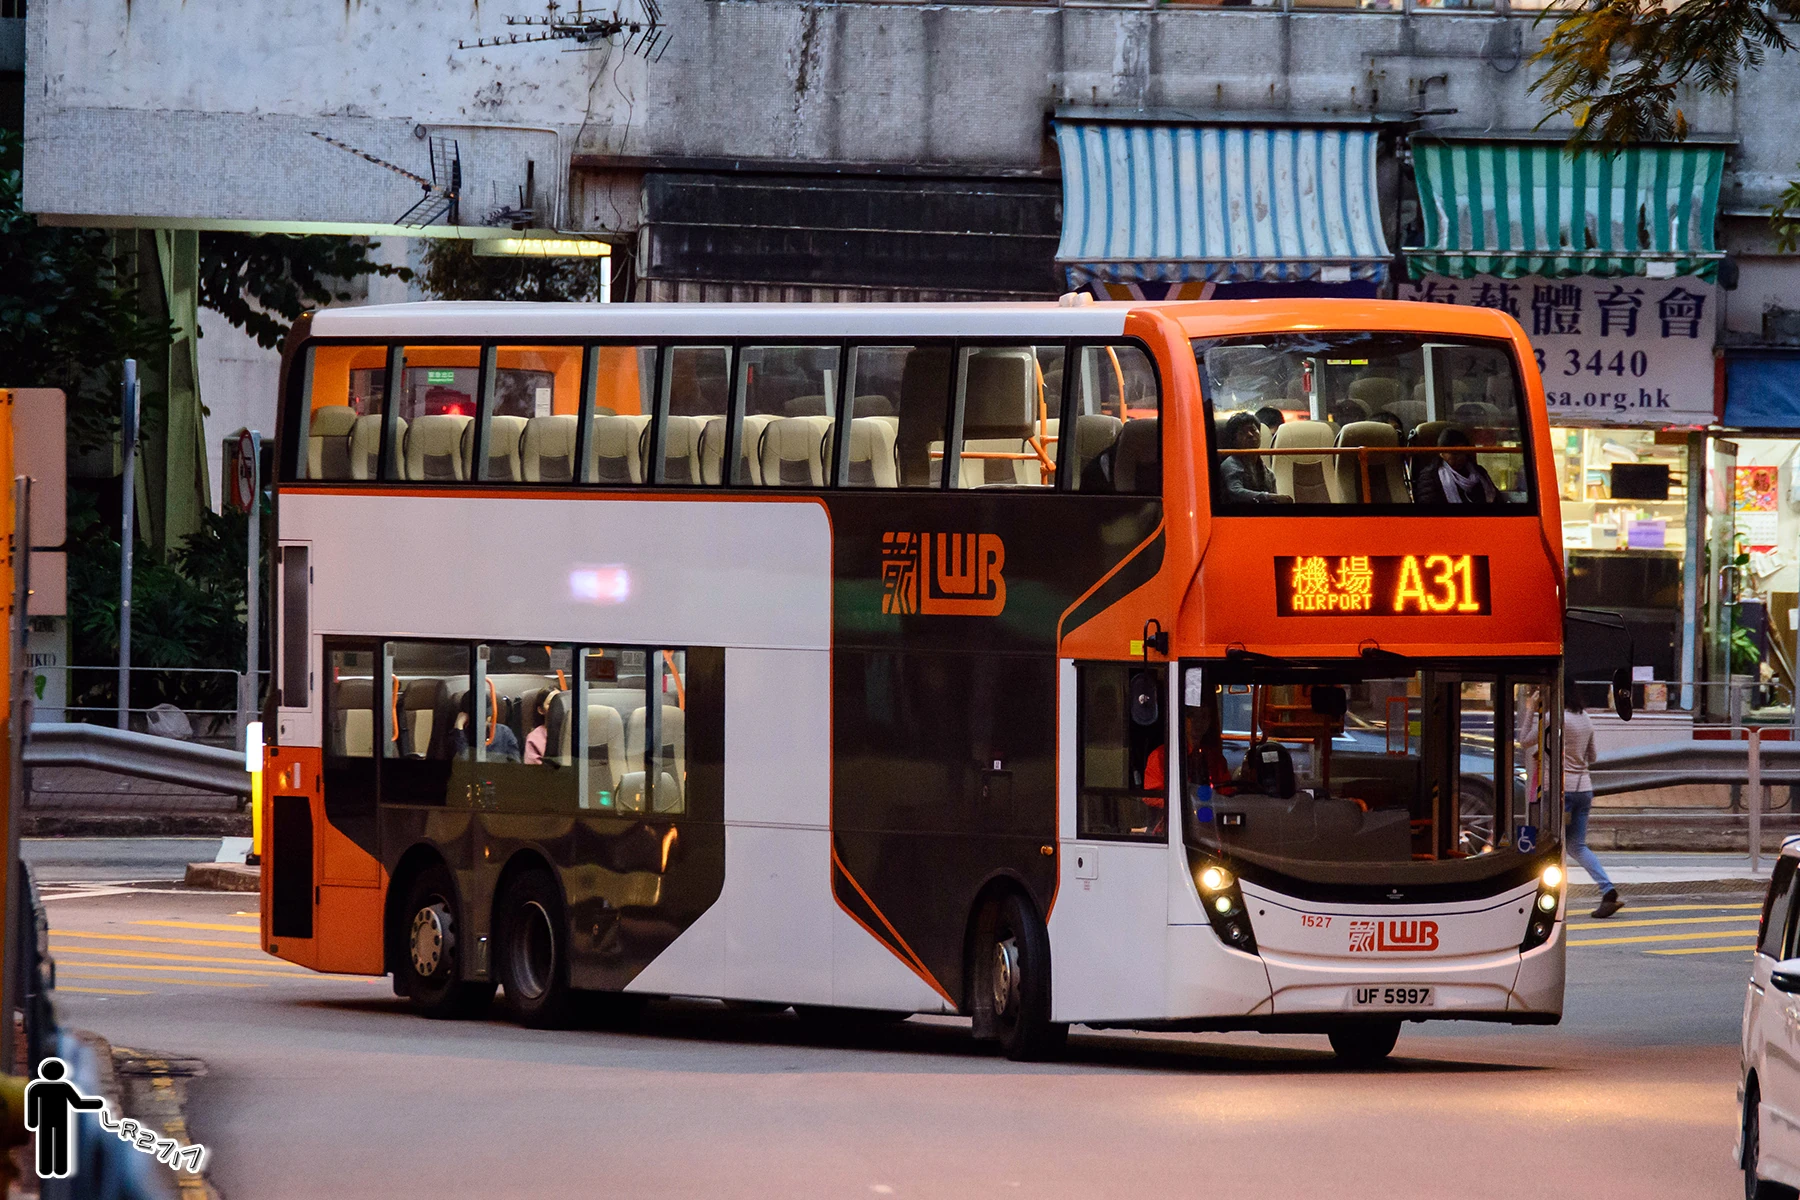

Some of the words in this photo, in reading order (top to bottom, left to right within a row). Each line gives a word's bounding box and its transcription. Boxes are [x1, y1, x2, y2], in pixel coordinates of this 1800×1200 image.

[1563, 349, 1648, 377] 3440
[1546, 388, 1671, 412] sa.org.hk
[920, 532, 1007, 617] LWB
[1292, 555, 1374, 595] 機場
[1394, 554, 1480, 612] A31
[1292, 594, 1373, 611] AIRPORT
[1301, 914, 1332, 929] 1527
[1377, 920, 1440, 952] LWB
[1356, 988, 1380, 1005] UF
[1384, 988, 1430, 1005] 5997
